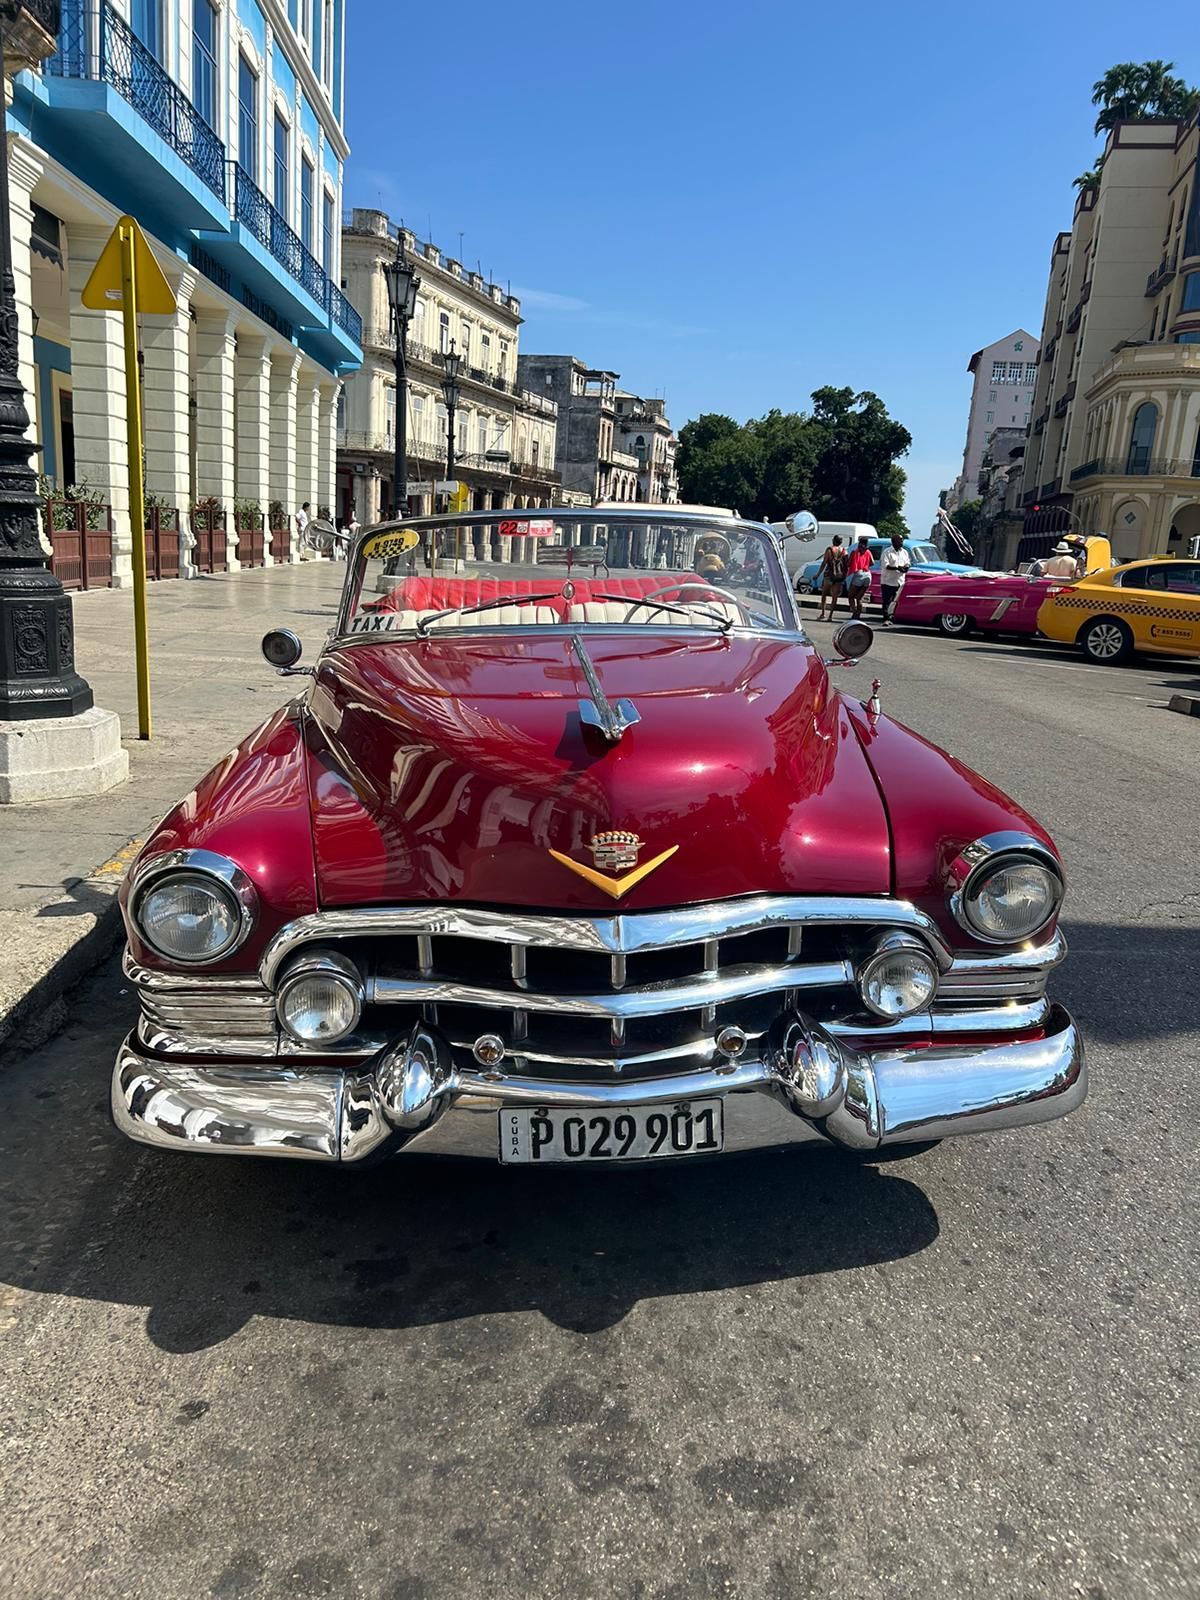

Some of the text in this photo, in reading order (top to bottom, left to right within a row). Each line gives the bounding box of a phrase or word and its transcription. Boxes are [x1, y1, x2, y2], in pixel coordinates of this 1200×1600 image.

[500, 521, 518, 534] 22
[351, 616, 395, 632] TAXI
[511, 1116, 519, 1156] CUBA
[530, 1109, 718, 1159] P 029 901
